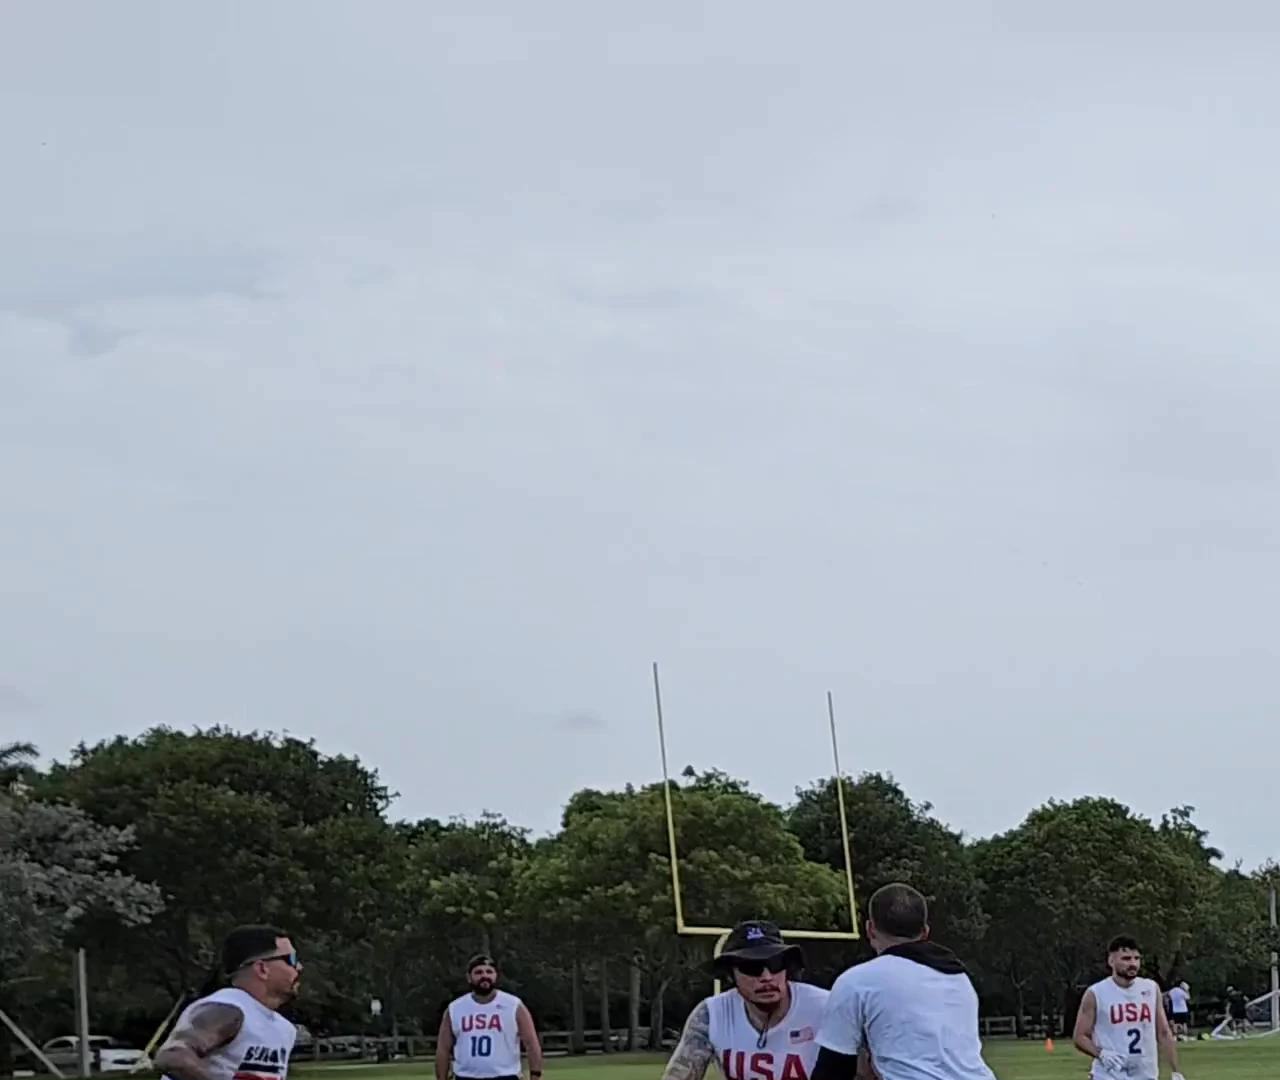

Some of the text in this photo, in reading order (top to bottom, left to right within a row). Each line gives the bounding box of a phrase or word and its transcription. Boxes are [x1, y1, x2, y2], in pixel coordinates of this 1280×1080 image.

[461, 1013, 502, 1032] USA
[1110, 1003, 1151, 1024] USA
[471, 1035, 491, 1057] 10
[1127, 1028, 1142, 1054] 2
